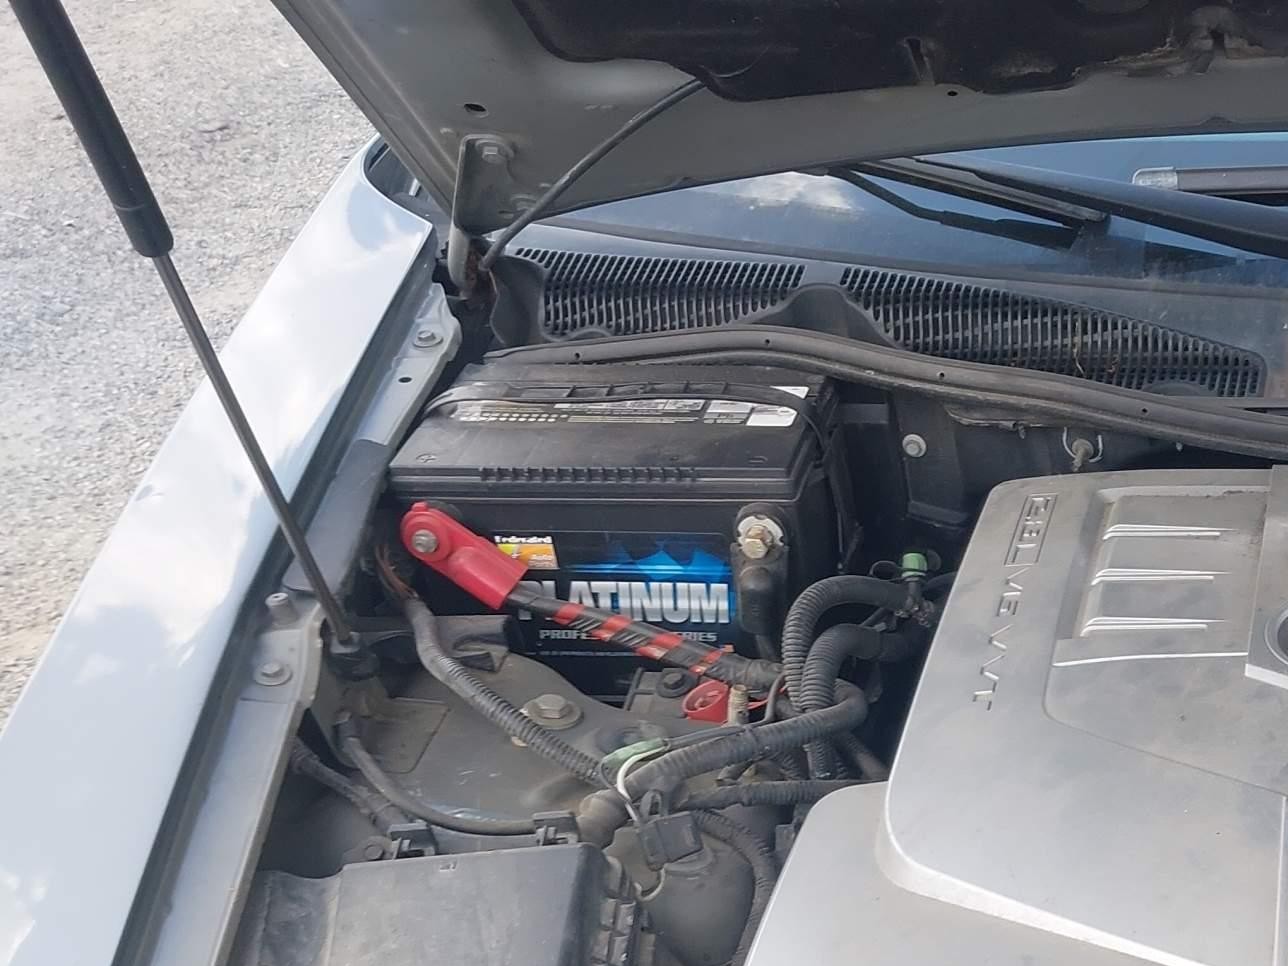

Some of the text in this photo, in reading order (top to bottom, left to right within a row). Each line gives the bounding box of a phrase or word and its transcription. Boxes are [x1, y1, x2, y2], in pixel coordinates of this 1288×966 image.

[518, 580, 730, 623] LATINUM
[996, 567, 1029, 617] V6
[973, 624, 1014, 711] VVT
